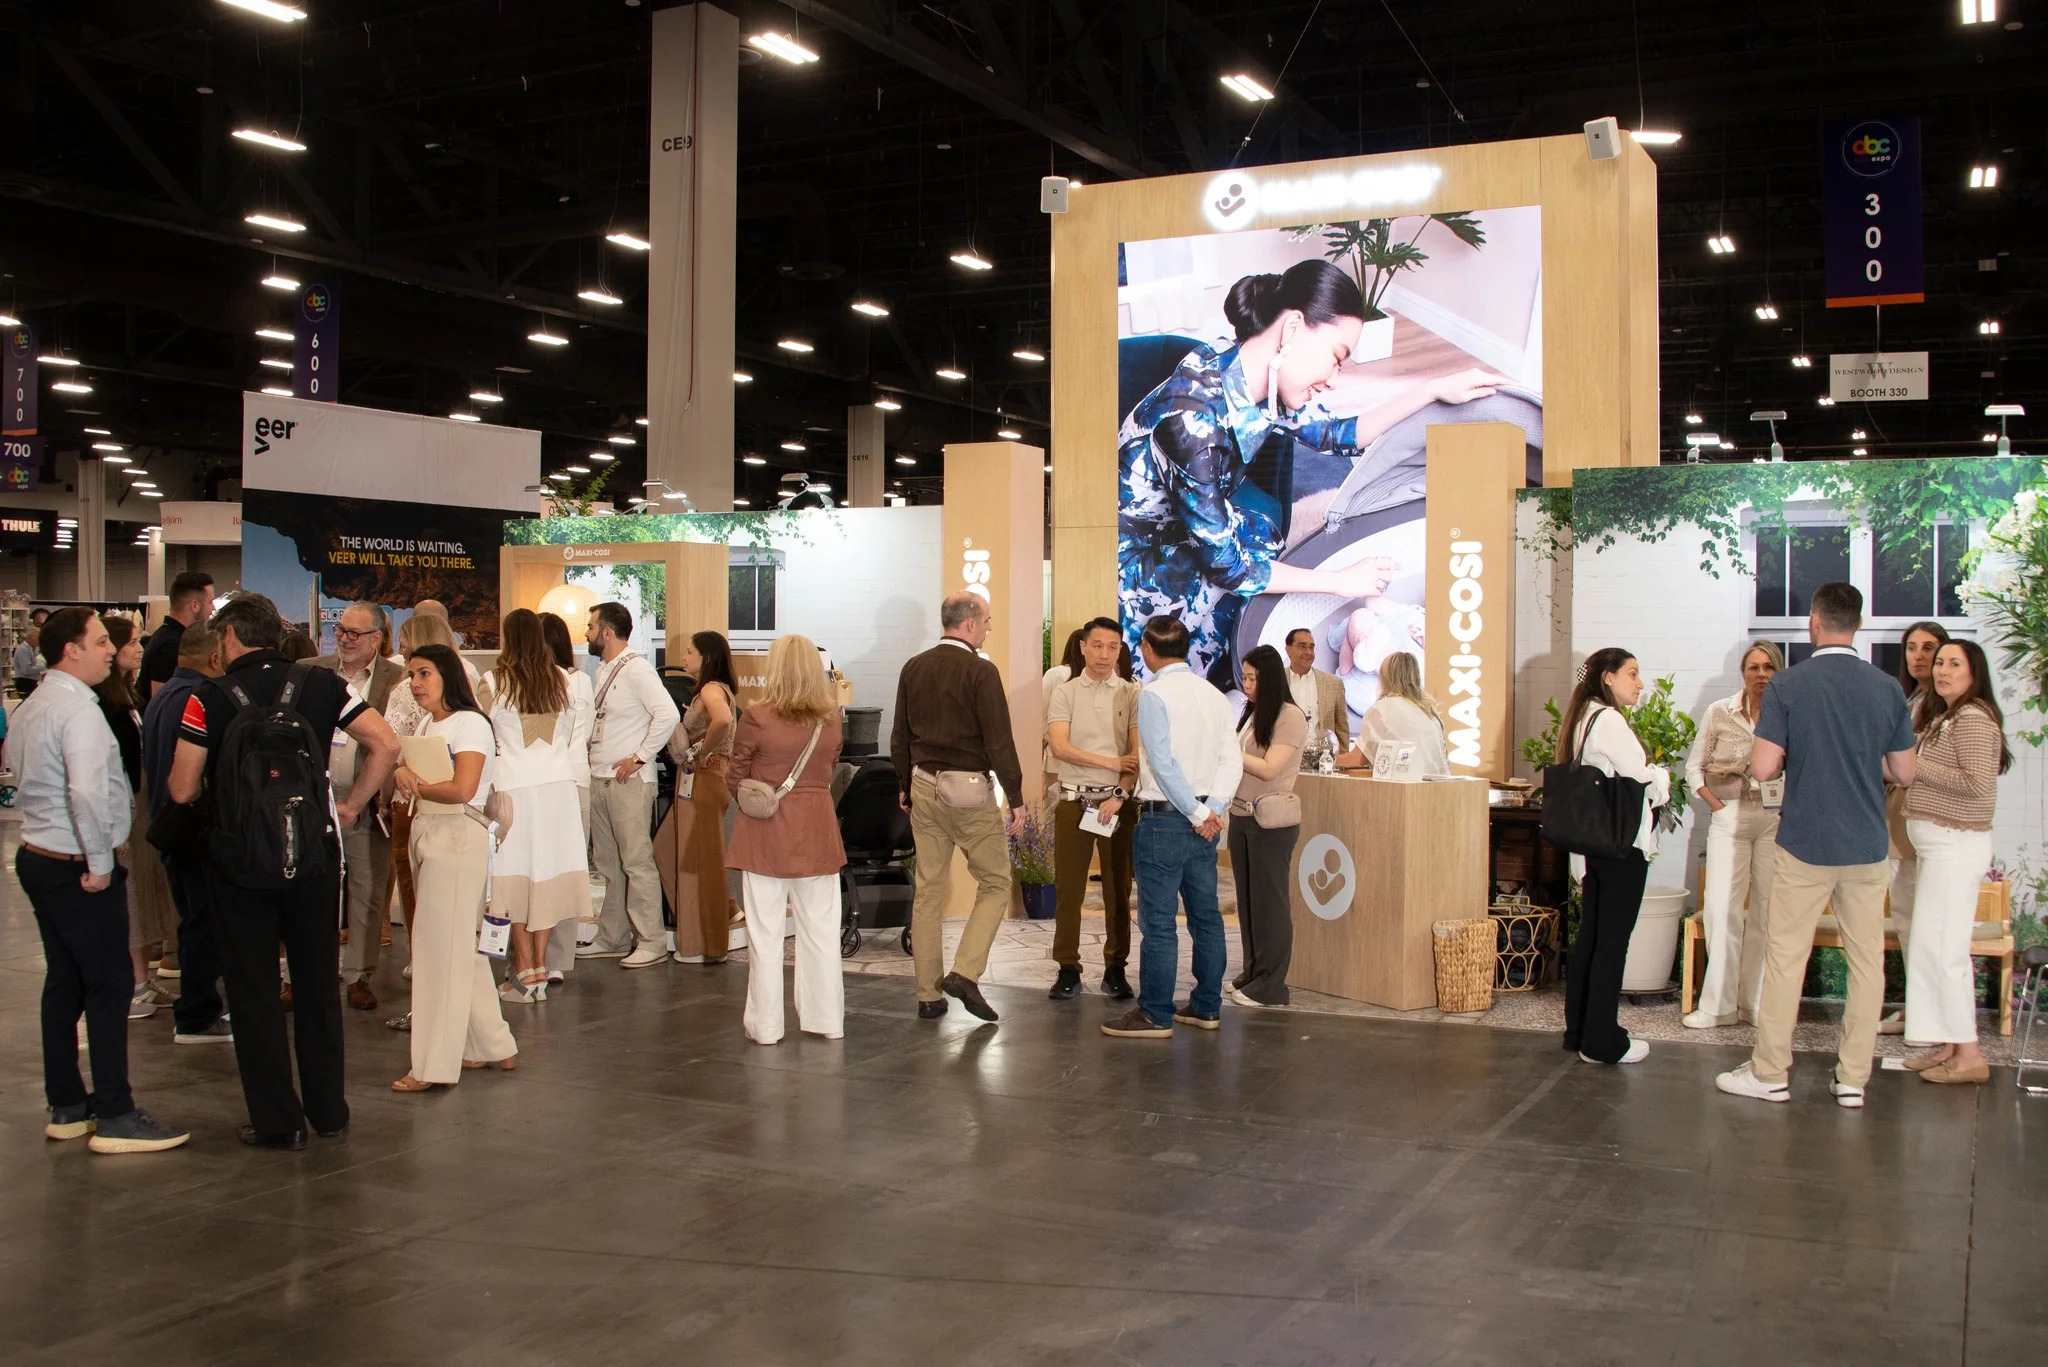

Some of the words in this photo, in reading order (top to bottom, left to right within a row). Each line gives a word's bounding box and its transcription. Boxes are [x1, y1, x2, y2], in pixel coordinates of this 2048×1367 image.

[661, 135, 693, 153] CE9
[1852, 134, 1891, 155] abc
[1871, 155, 1891, 163] expo
[1889, 366, 1925, 375] DESIGN
[1850, 388, 1886, 398] BOOTH
[1889, 387, 1908, 398] 330
[3, 442, 31, 458] 700
[1, 519, 41, 533] THULE
[339, 535, 361, 549] THE
[363, 537, 404, 551] WORLD
[406, 539, 416, 552] IS
[417, 540, 467, 555] WAITING.
[328, 551, 356, 565] VEER
[358, 552, 386, 566] WILL
[387, 553, 414, 567] TAKE
[416, 555, 438, 568] YOU
[440, 556, 476, 570] THERE.
